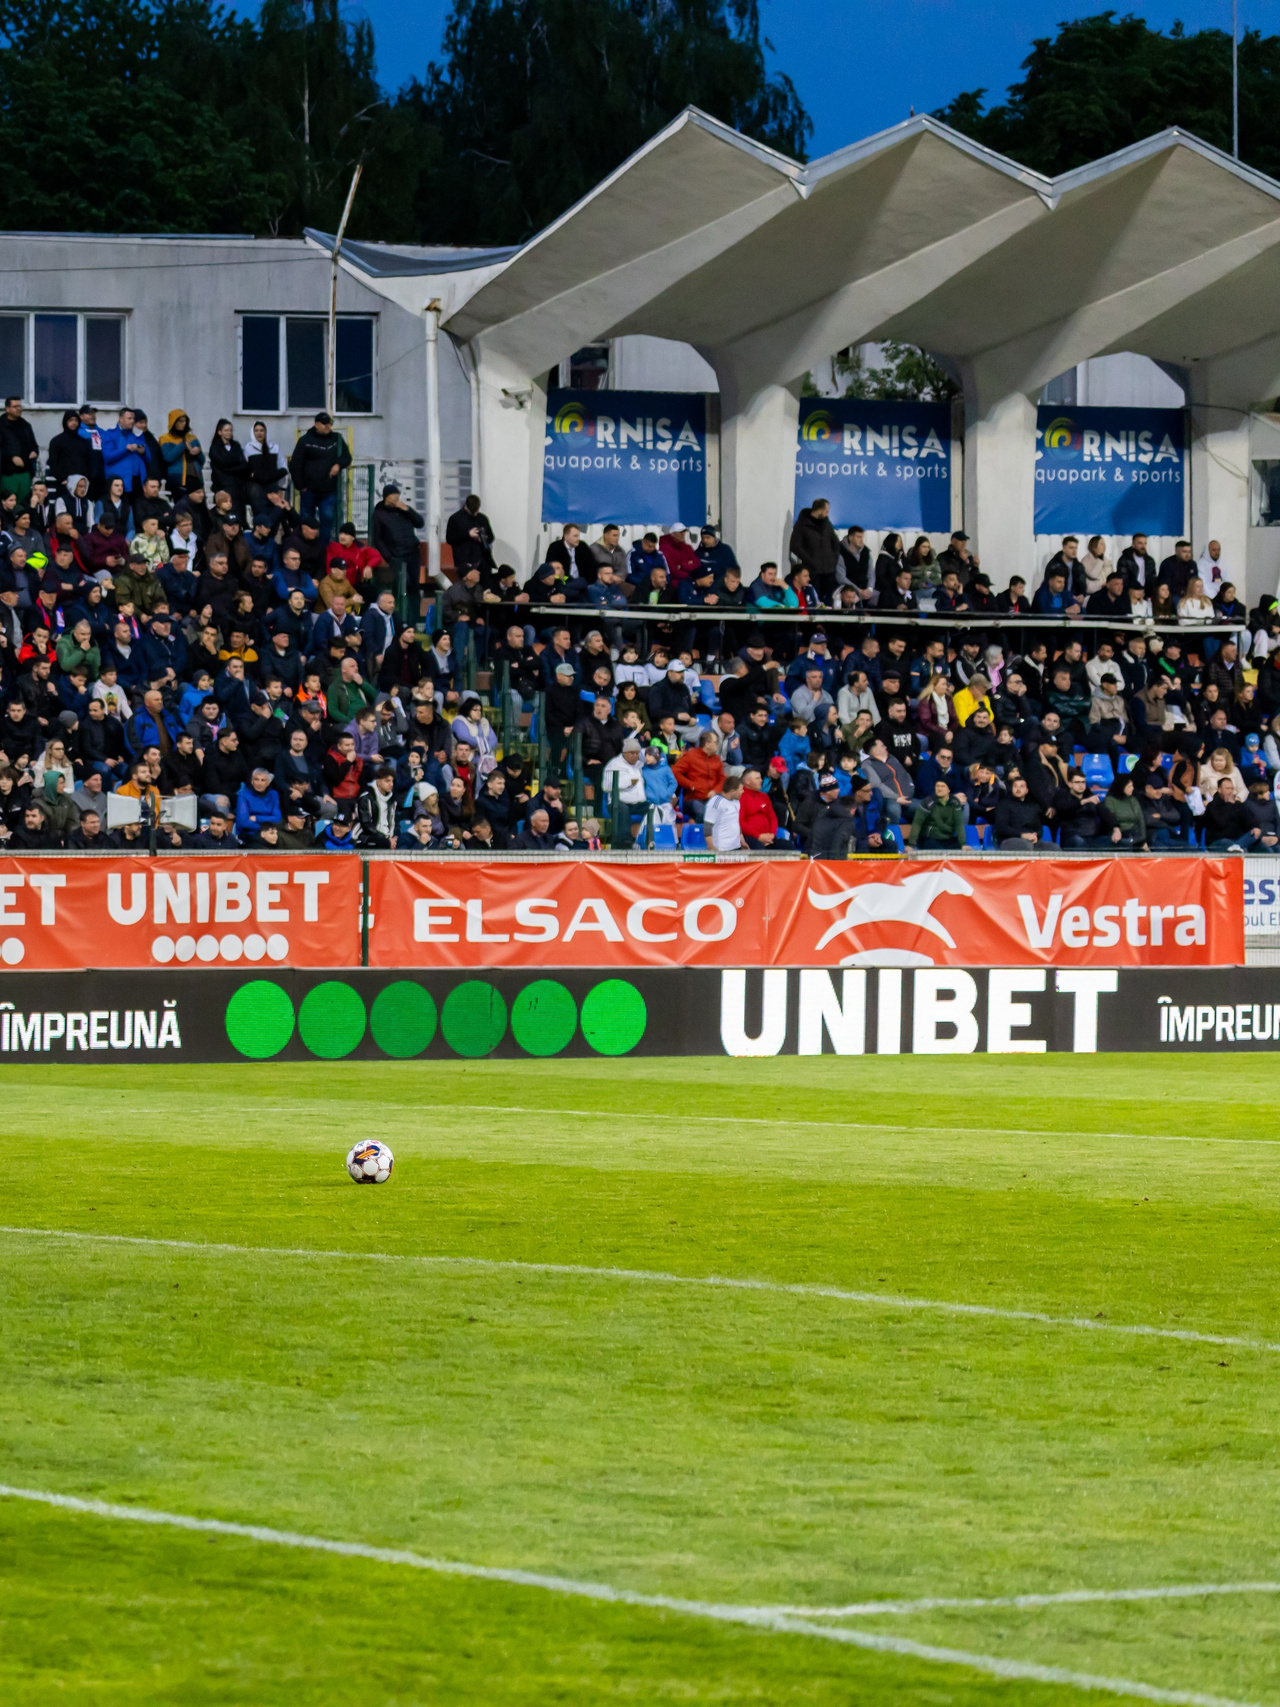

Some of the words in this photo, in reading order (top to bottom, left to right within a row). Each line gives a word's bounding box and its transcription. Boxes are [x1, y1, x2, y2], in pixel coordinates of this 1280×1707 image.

[545, 454, 621, 471] quapark
[630, 455, 641, 470] &
[649, 456, 703, 473] sports
[796, 461, 869, 478] quapark
[877, 461, 888, 477] &
[895, 463, 948, 480] sports
[1036, 467, 1107, 485] quapark
[1114, 467, 1124, 482] &
[1131, 468, 1181, 485] sports
[108, 870, 330, 925] UNIBET
[413, 898, 738, 943] ELSACO
[1017, 894, 1206, 949] Vestra
[720, 968, 1118, 1058] UNIBET
